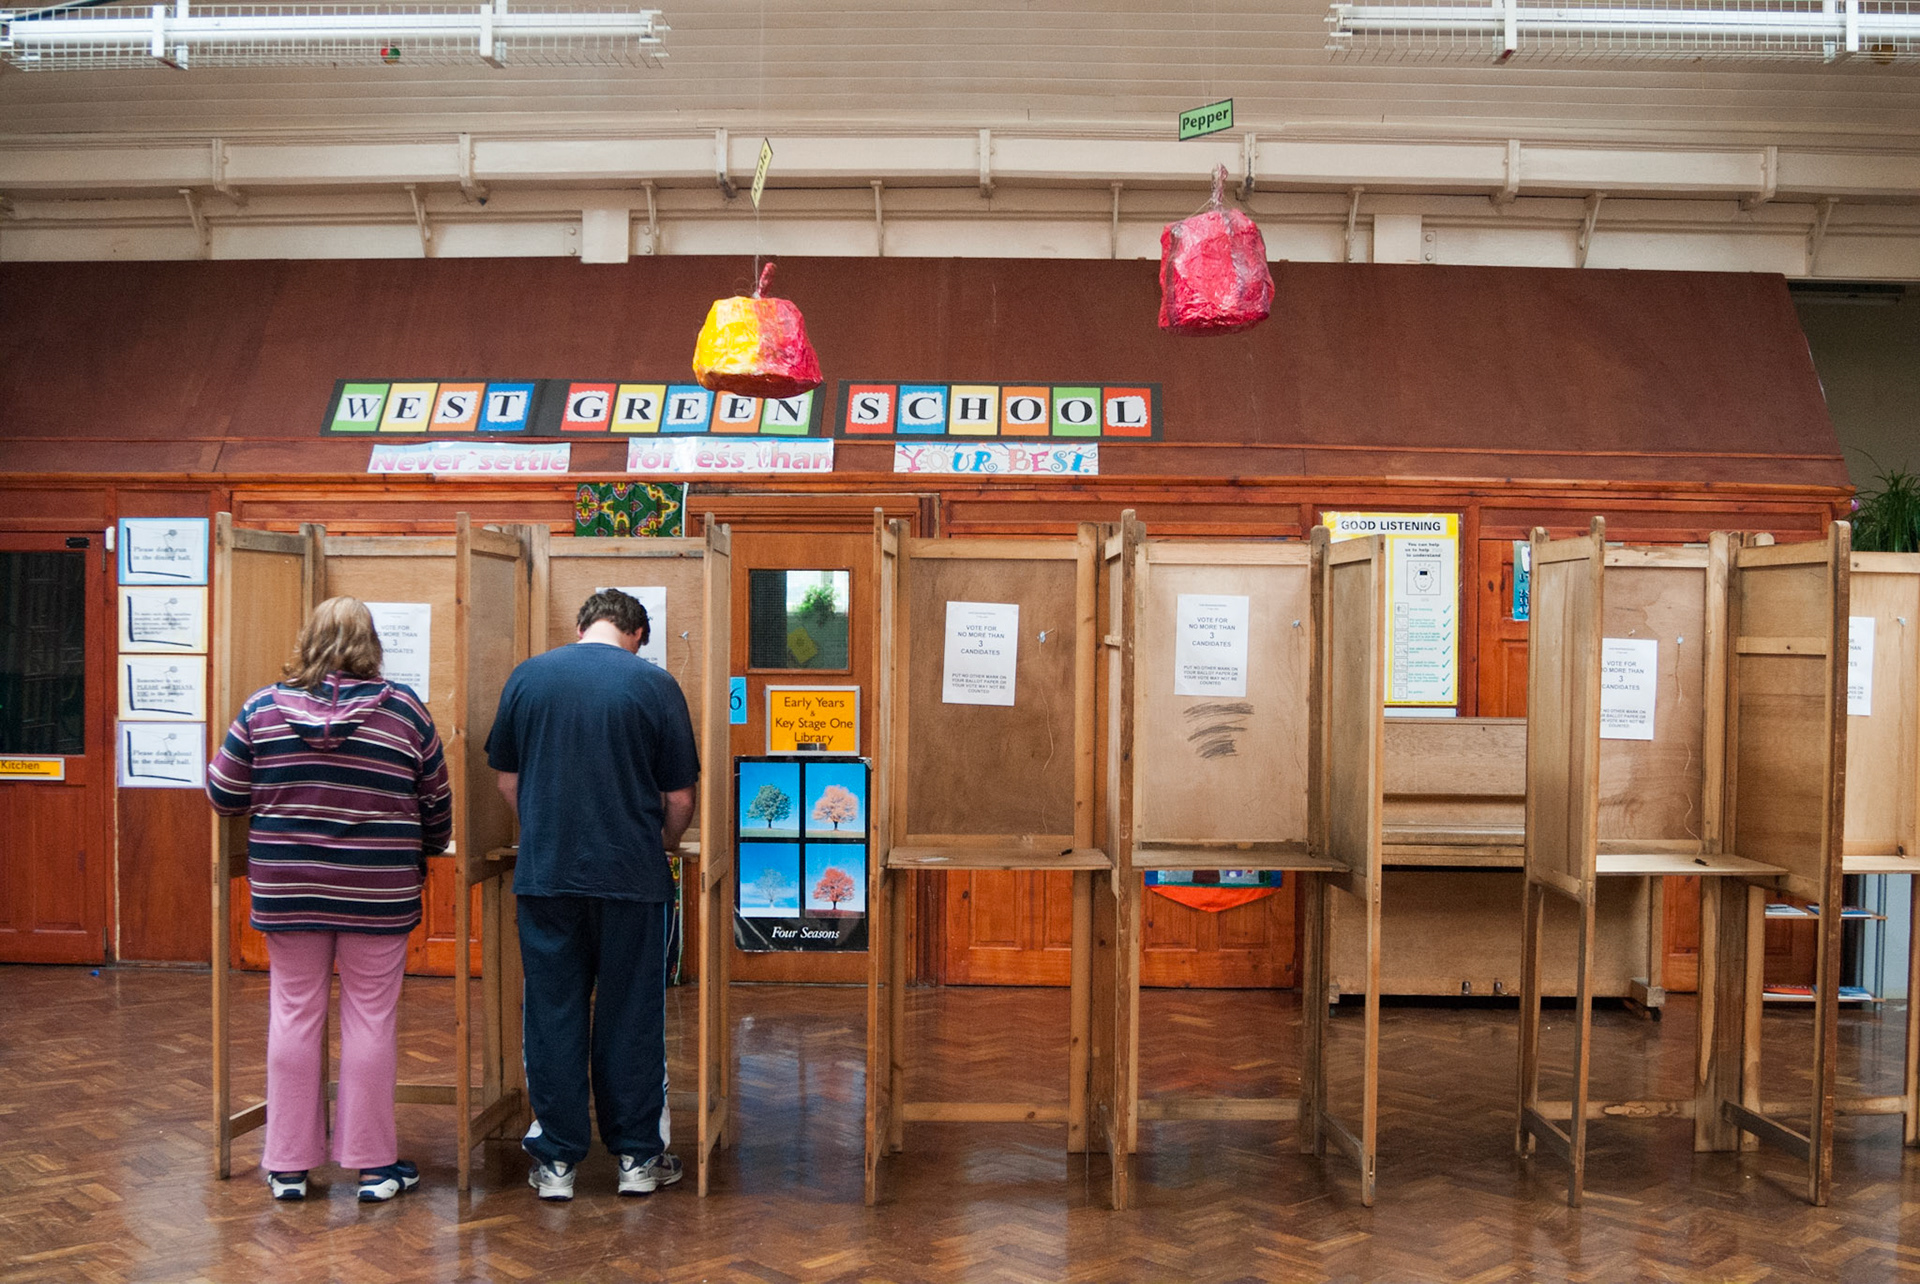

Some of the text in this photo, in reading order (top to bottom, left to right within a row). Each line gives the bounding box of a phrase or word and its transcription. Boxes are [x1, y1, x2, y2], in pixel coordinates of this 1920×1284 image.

[1182, 109, 1229, 130] Pepper
[347, 394, 1141, 423] WEST GREEN SCHOOL
[371, 452, 569, 471] Never settle
[629, 443, 831, 469] for ess than
[896, 449, 998, 472] YOUR
[1341, 520, 1441, 531] GOOD LISTENING
[1618, 675, 1624, 683] 3
[784, 696, 845, 710] Early Years
[775, 718, 853, 731] Key Stage One
[794, 732, 834, 745] Library
[1, 760, 40, 769] Kitchen
[772, 926, 840, 939] Four Seasons
